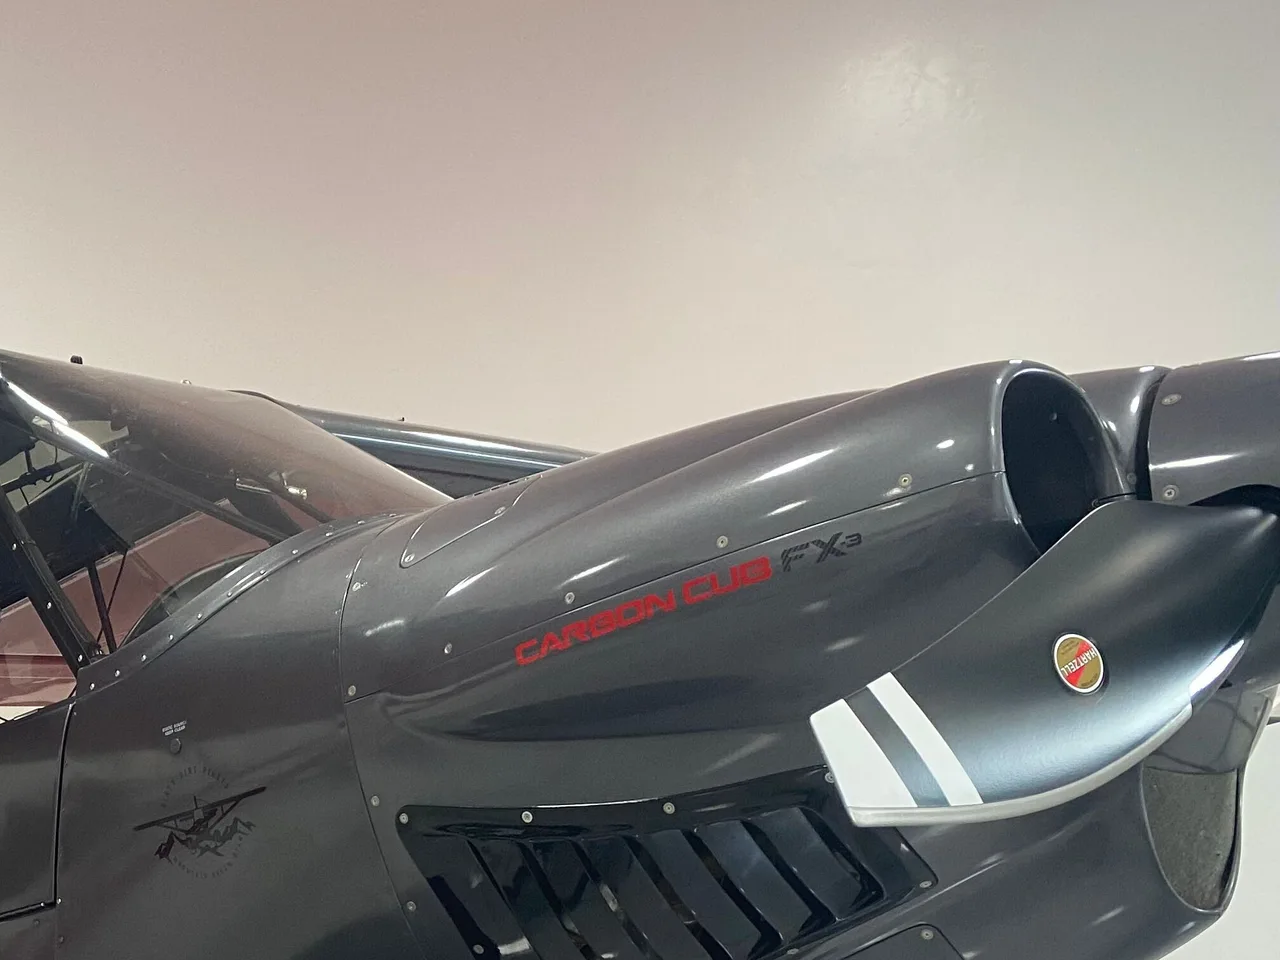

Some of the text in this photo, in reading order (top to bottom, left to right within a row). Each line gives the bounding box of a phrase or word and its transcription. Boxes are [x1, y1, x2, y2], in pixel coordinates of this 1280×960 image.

[514, 588, 677, 665] CARBON
[682, 555, 772, 604] CUB
[1061, 648, 1098, 676] HARTZELL
